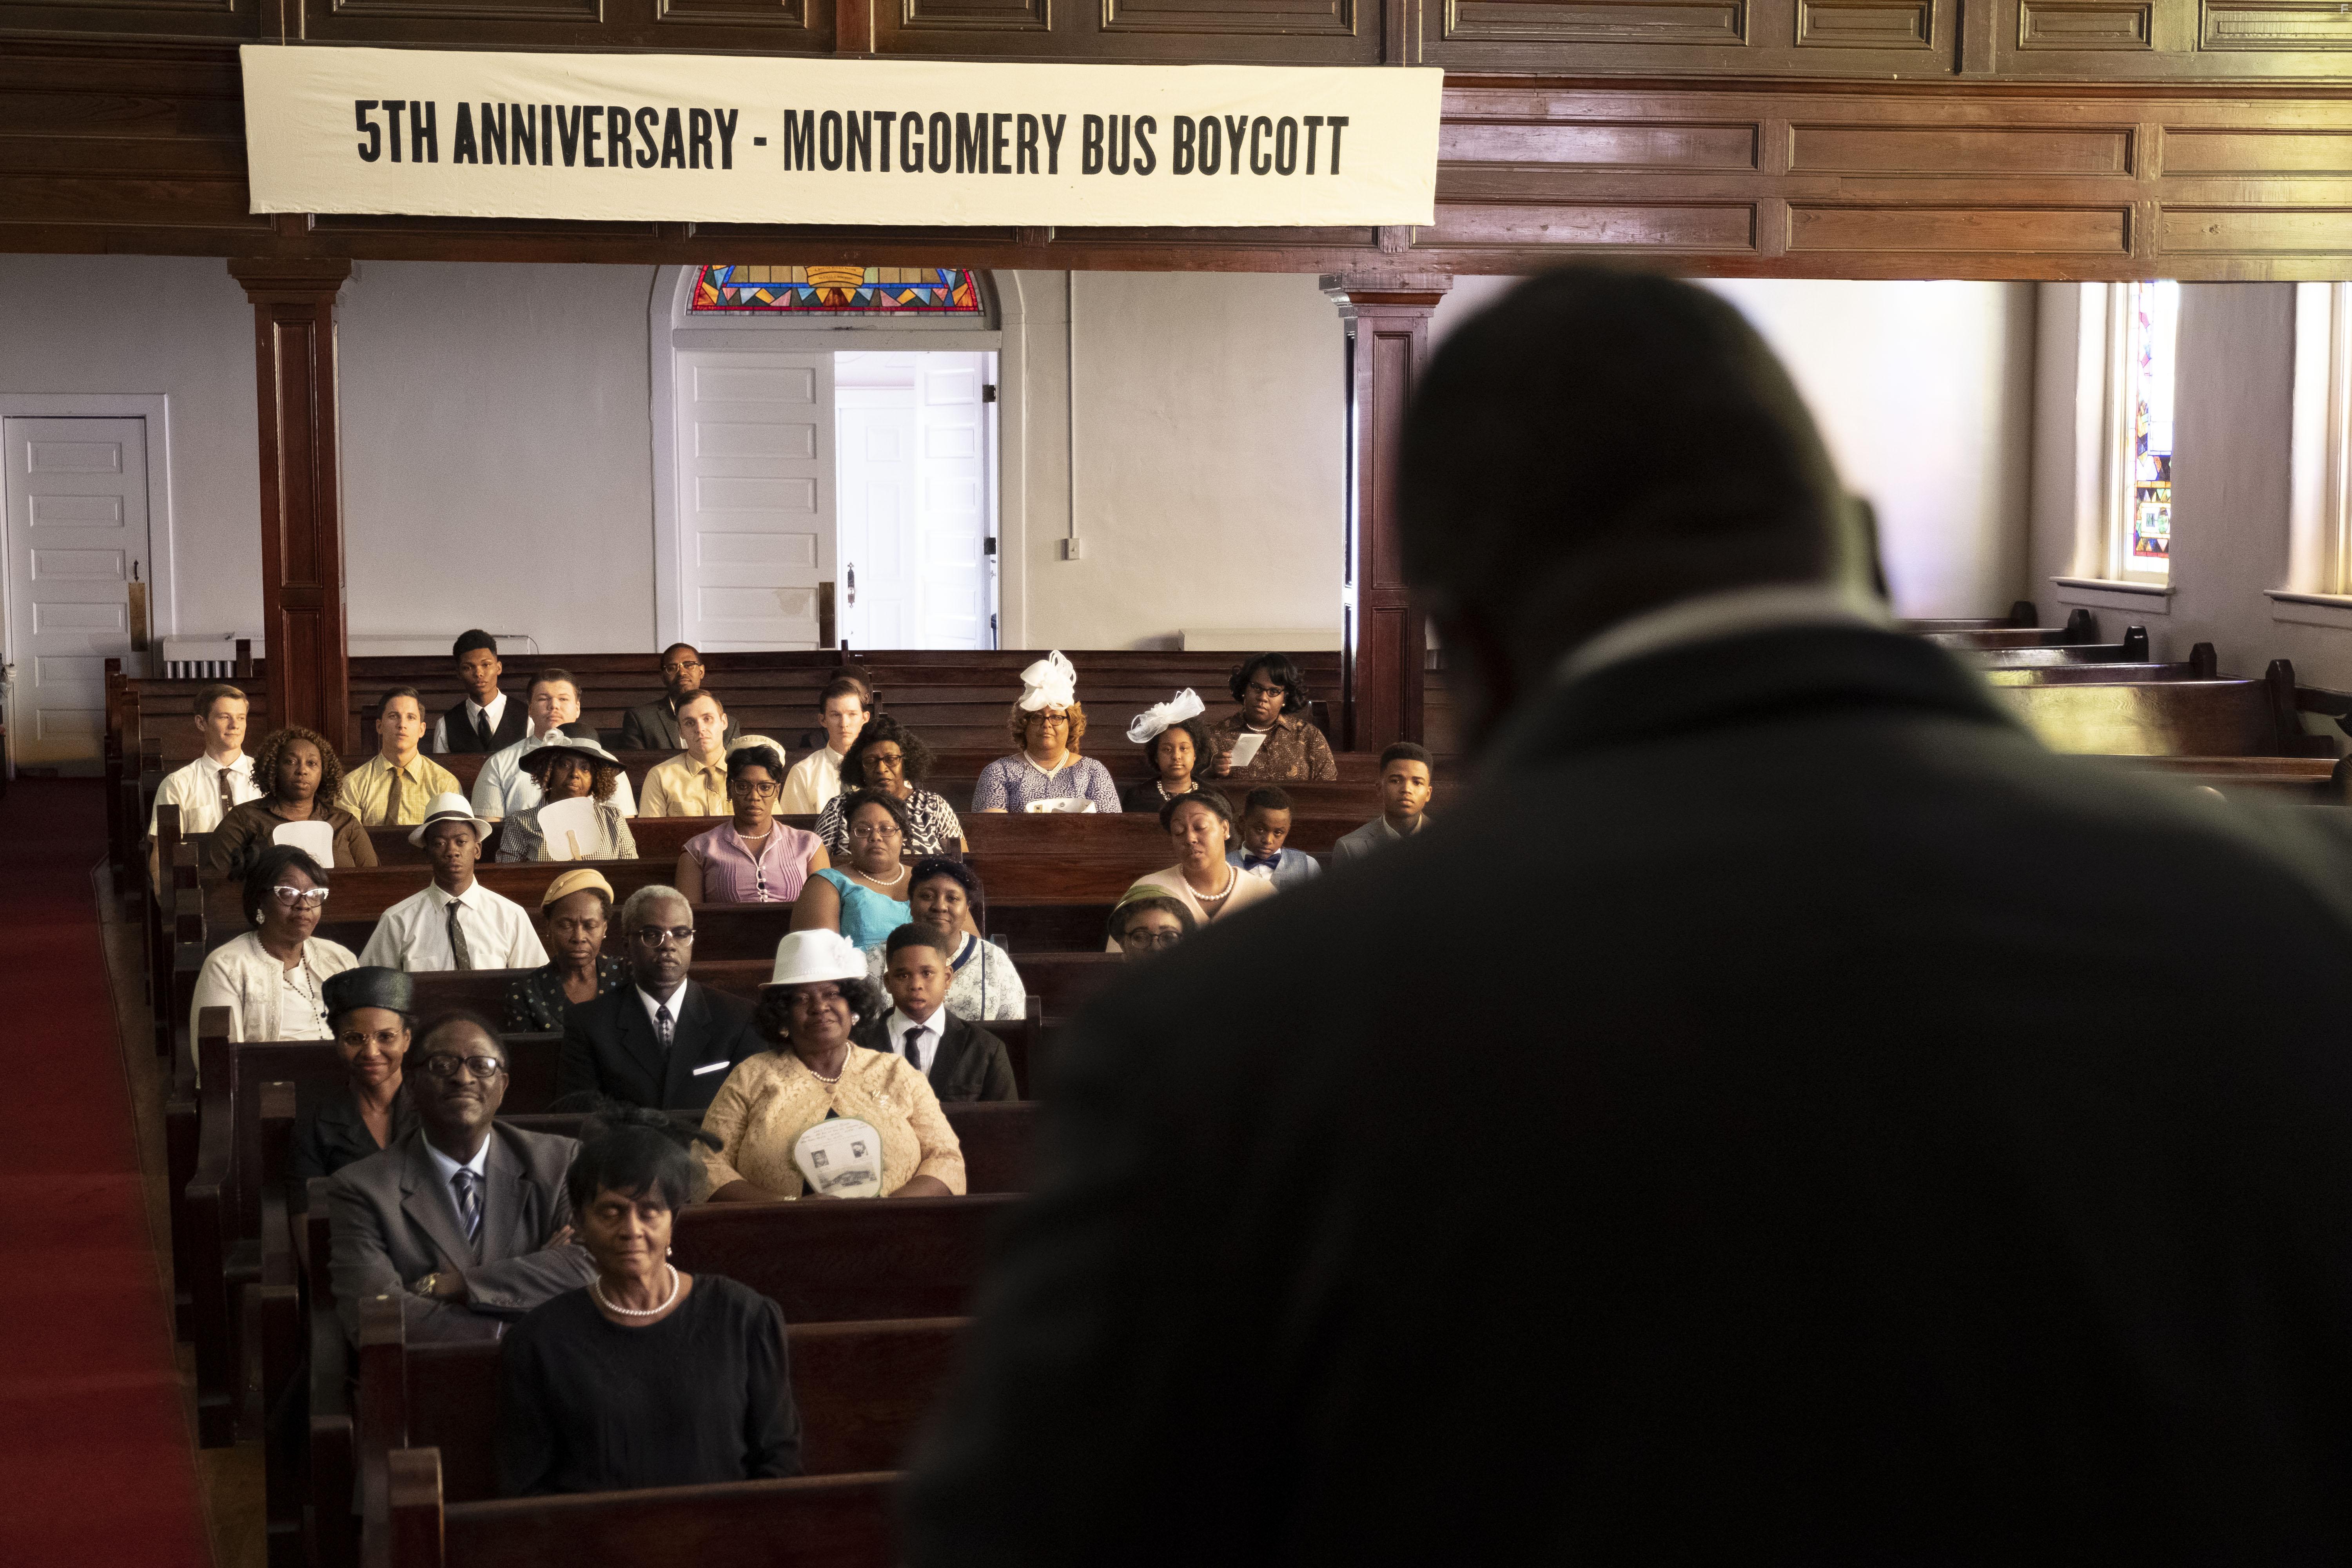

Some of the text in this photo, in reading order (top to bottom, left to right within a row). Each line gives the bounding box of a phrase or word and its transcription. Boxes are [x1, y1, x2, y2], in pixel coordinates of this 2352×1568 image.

[355, 100, 1349, 176] 5TH ANNIVERSARY - MONTGOMERY BUS BOYCOTT
